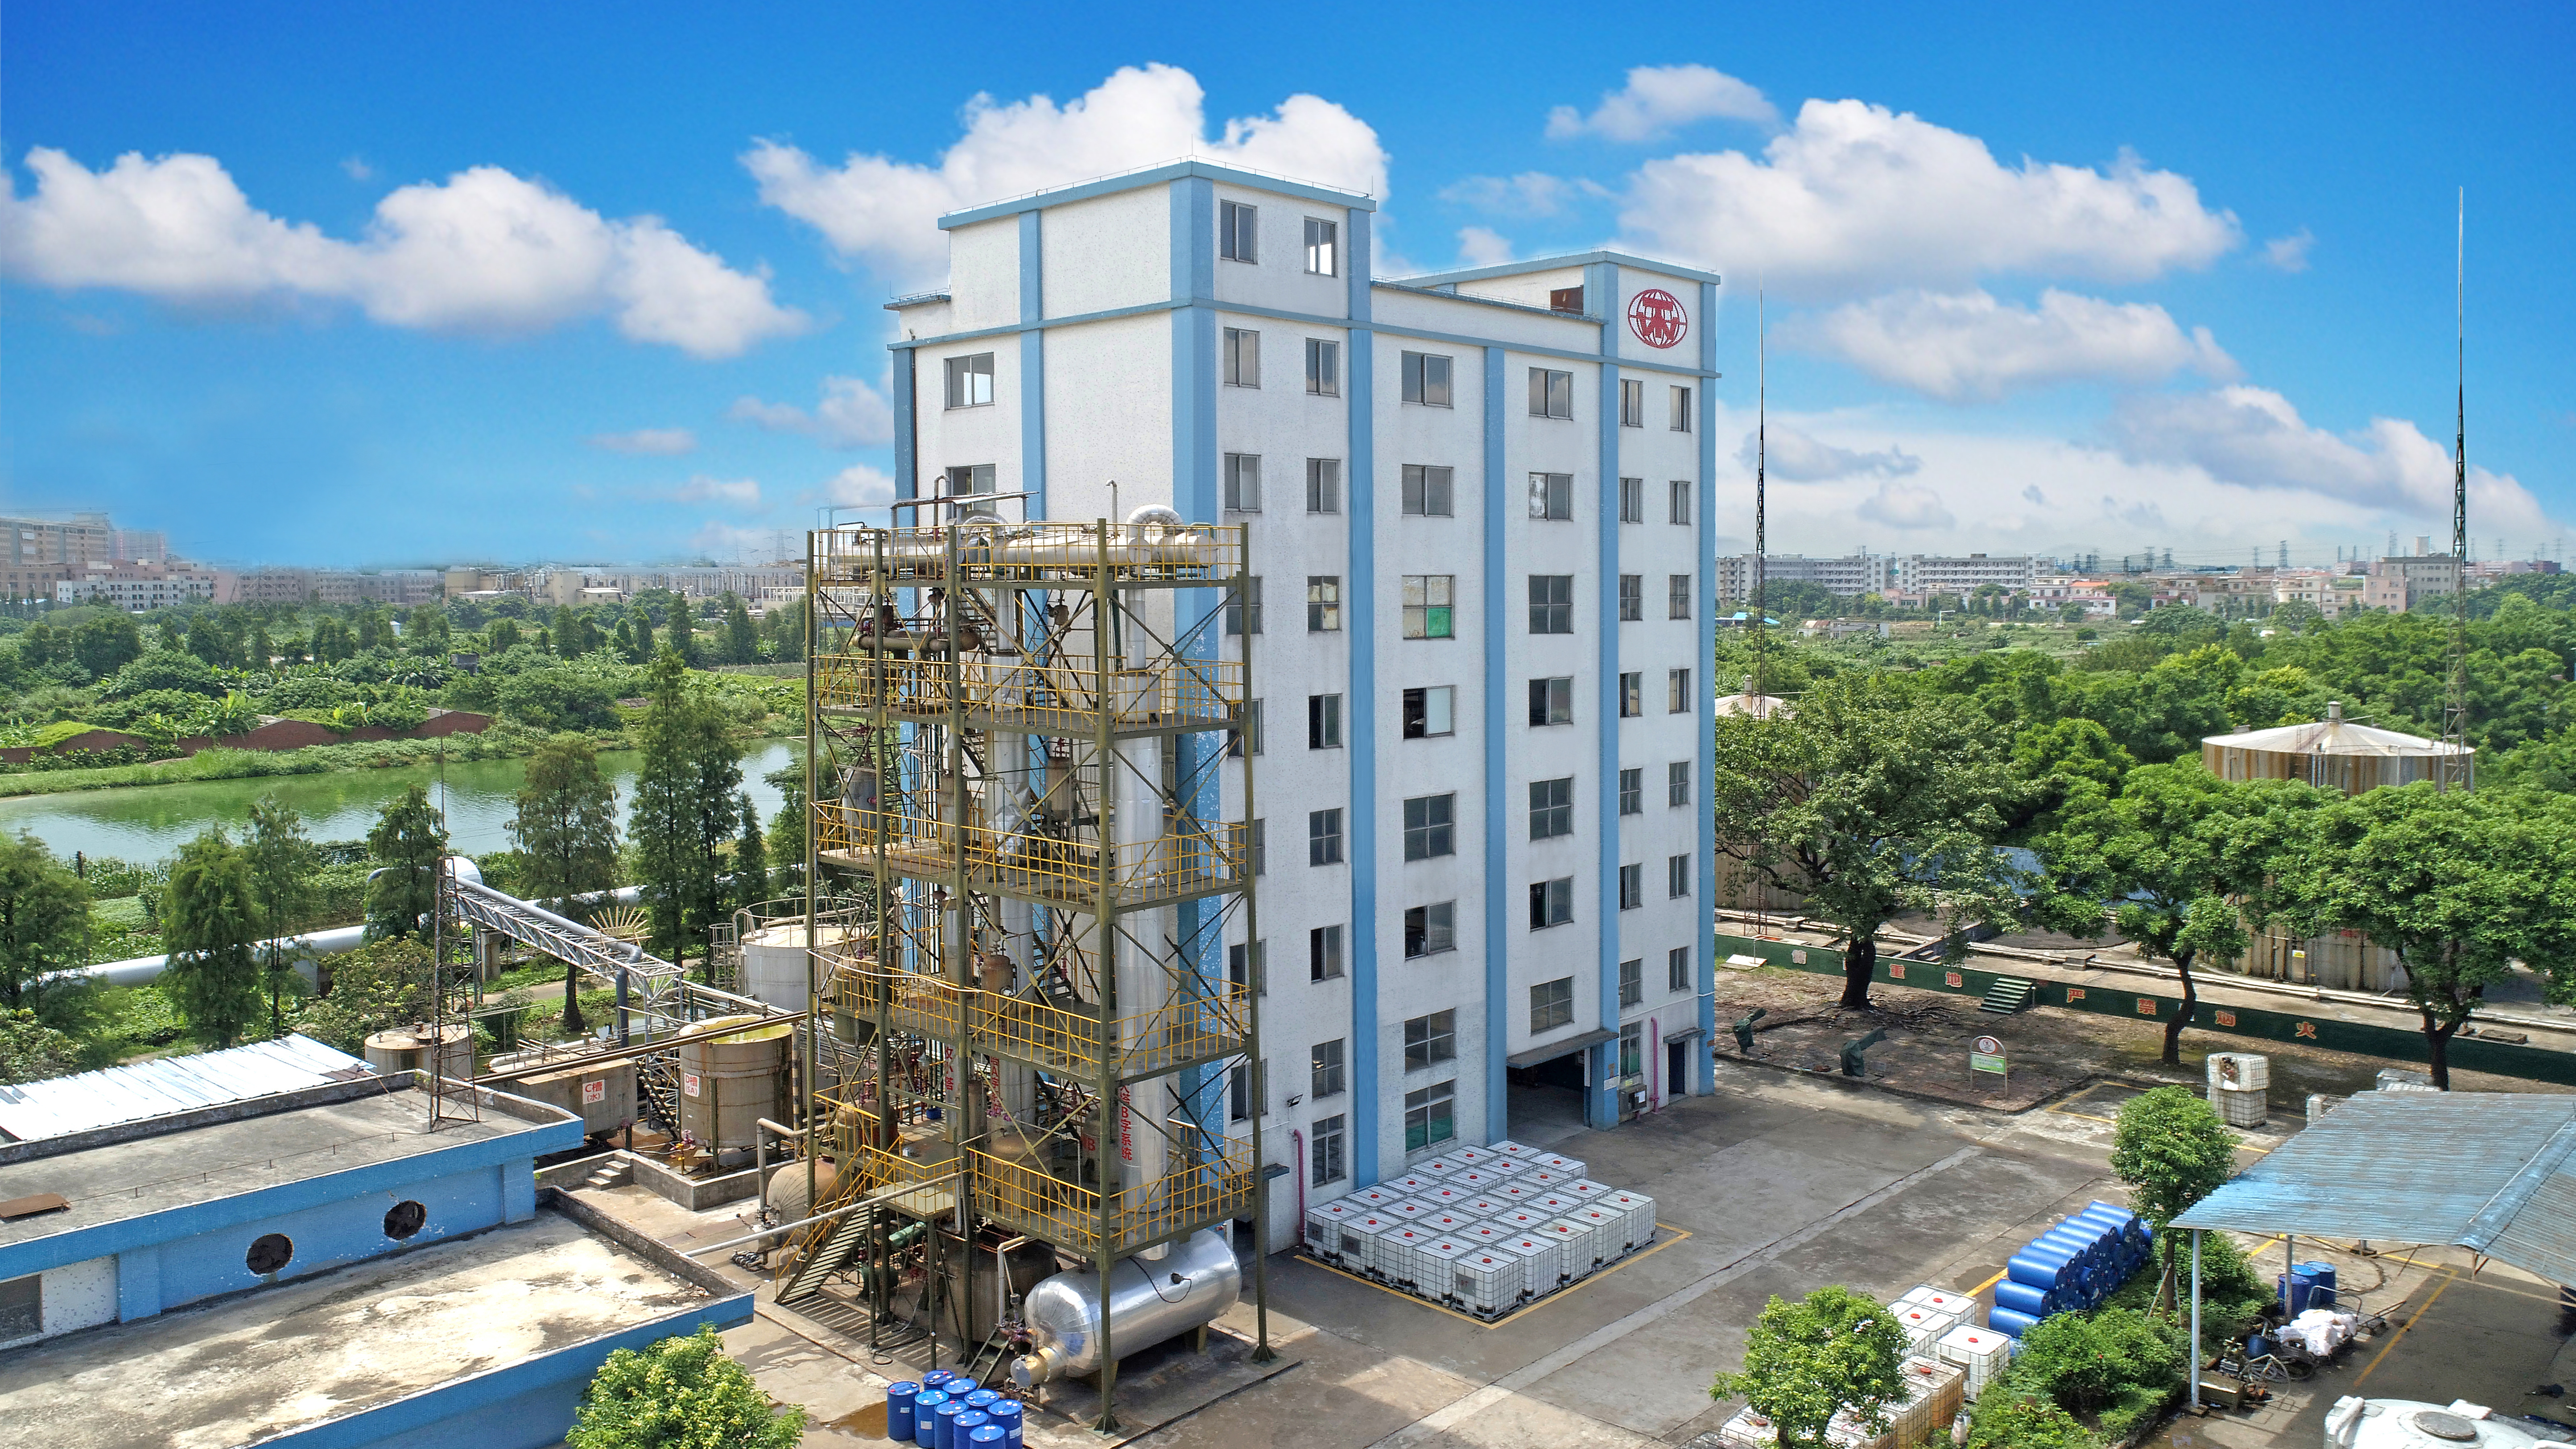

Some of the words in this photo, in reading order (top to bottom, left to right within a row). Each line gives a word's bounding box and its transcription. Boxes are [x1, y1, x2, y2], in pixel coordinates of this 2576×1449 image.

[2067, 987, 2317, 1040] 严禁烟火
[585, 1081, 603, 1092] C槽
[587, 1093, 600, 1102] (水)
